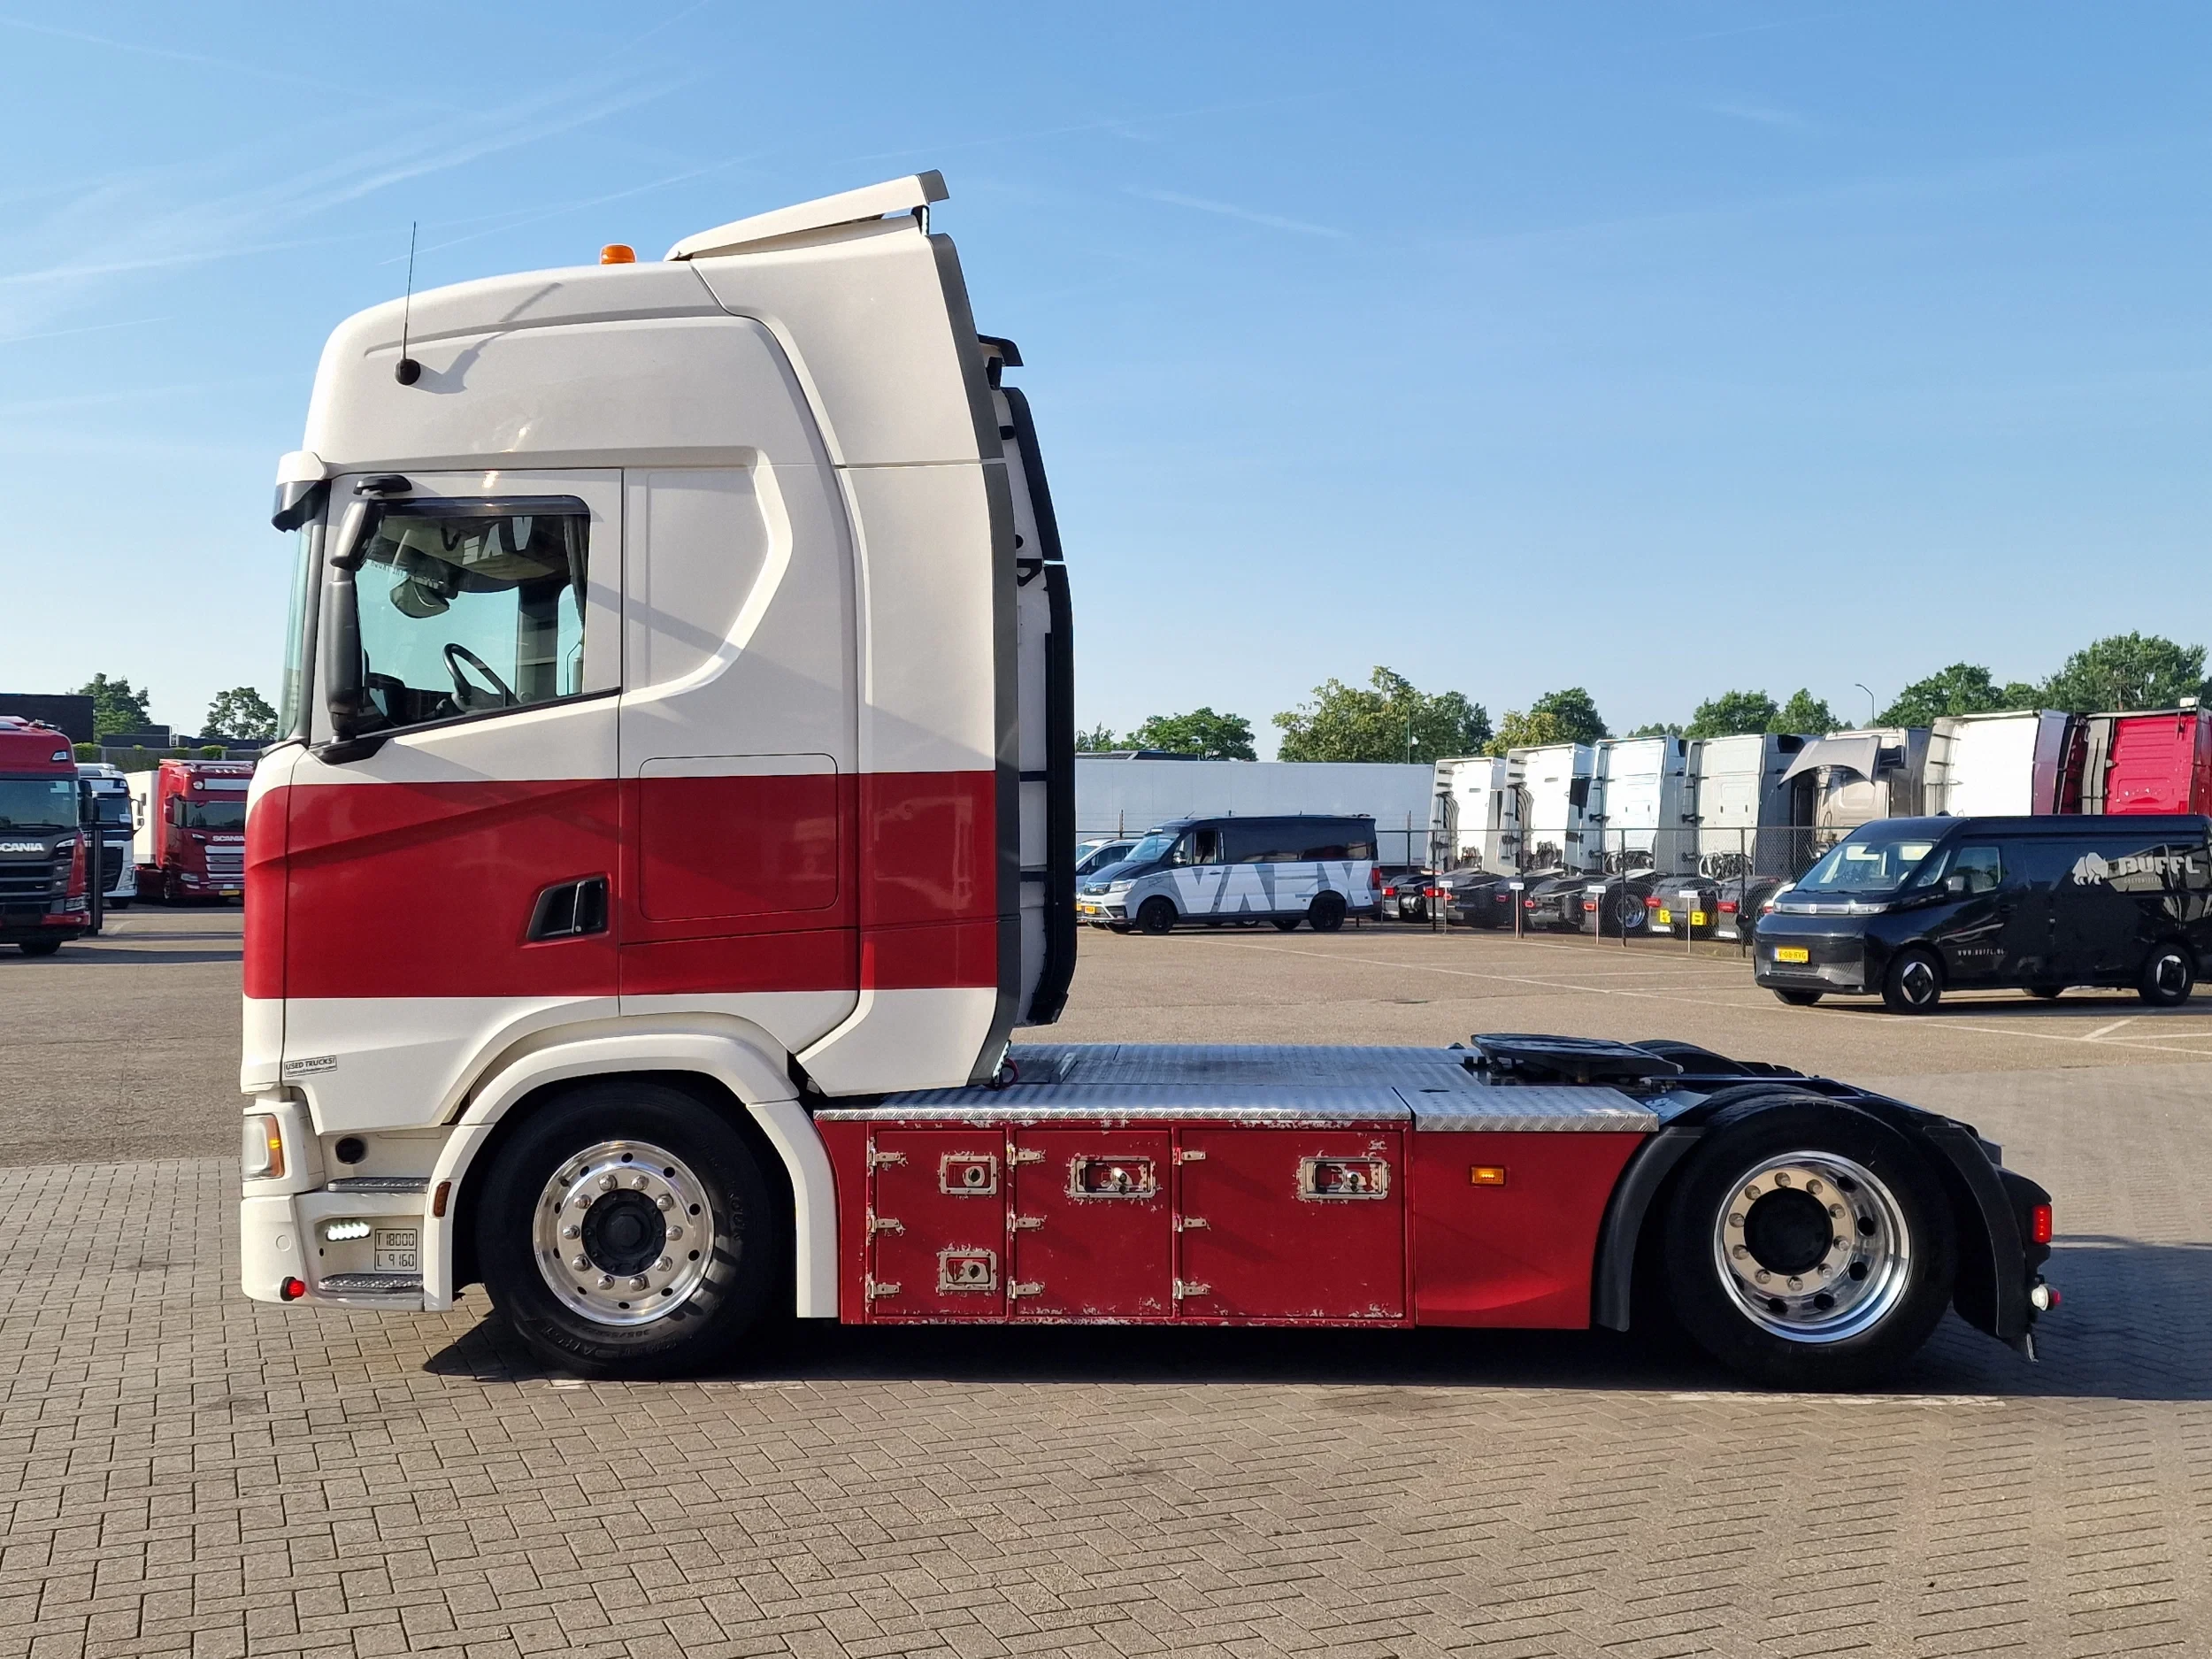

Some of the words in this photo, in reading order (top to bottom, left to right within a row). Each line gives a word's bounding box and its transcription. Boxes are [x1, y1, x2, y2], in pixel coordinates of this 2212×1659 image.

[2118, 855, 2200, 875] BUFFL
[377, 1233, 382, 1246] T
[386, 1233, 415, 1246] 18000
[377, 1254, 381, 1267] L
